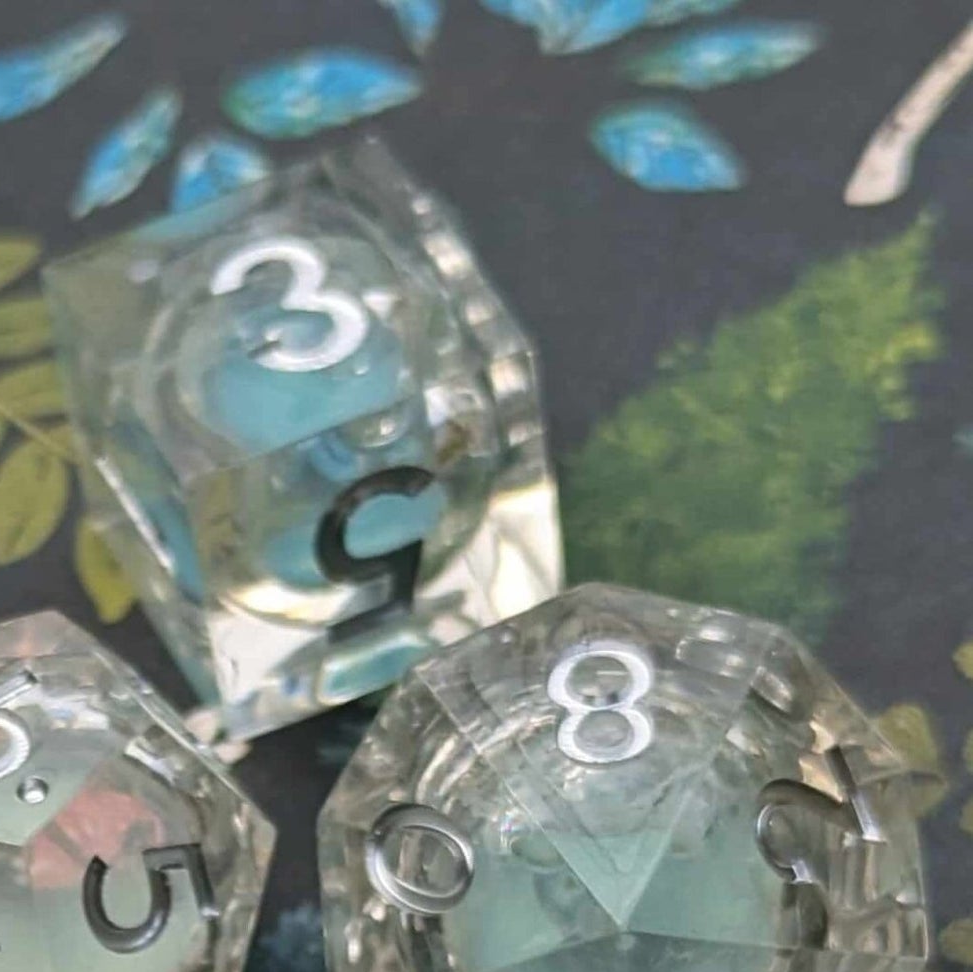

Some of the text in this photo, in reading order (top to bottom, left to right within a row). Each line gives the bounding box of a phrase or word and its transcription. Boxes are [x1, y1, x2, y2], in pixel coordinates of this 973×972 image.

[210, 238, 369, 373] 3
[545, 639, 655, 765] 8
[81, 841, 221, 956] 5
[365, 802, 476, 914] 0
